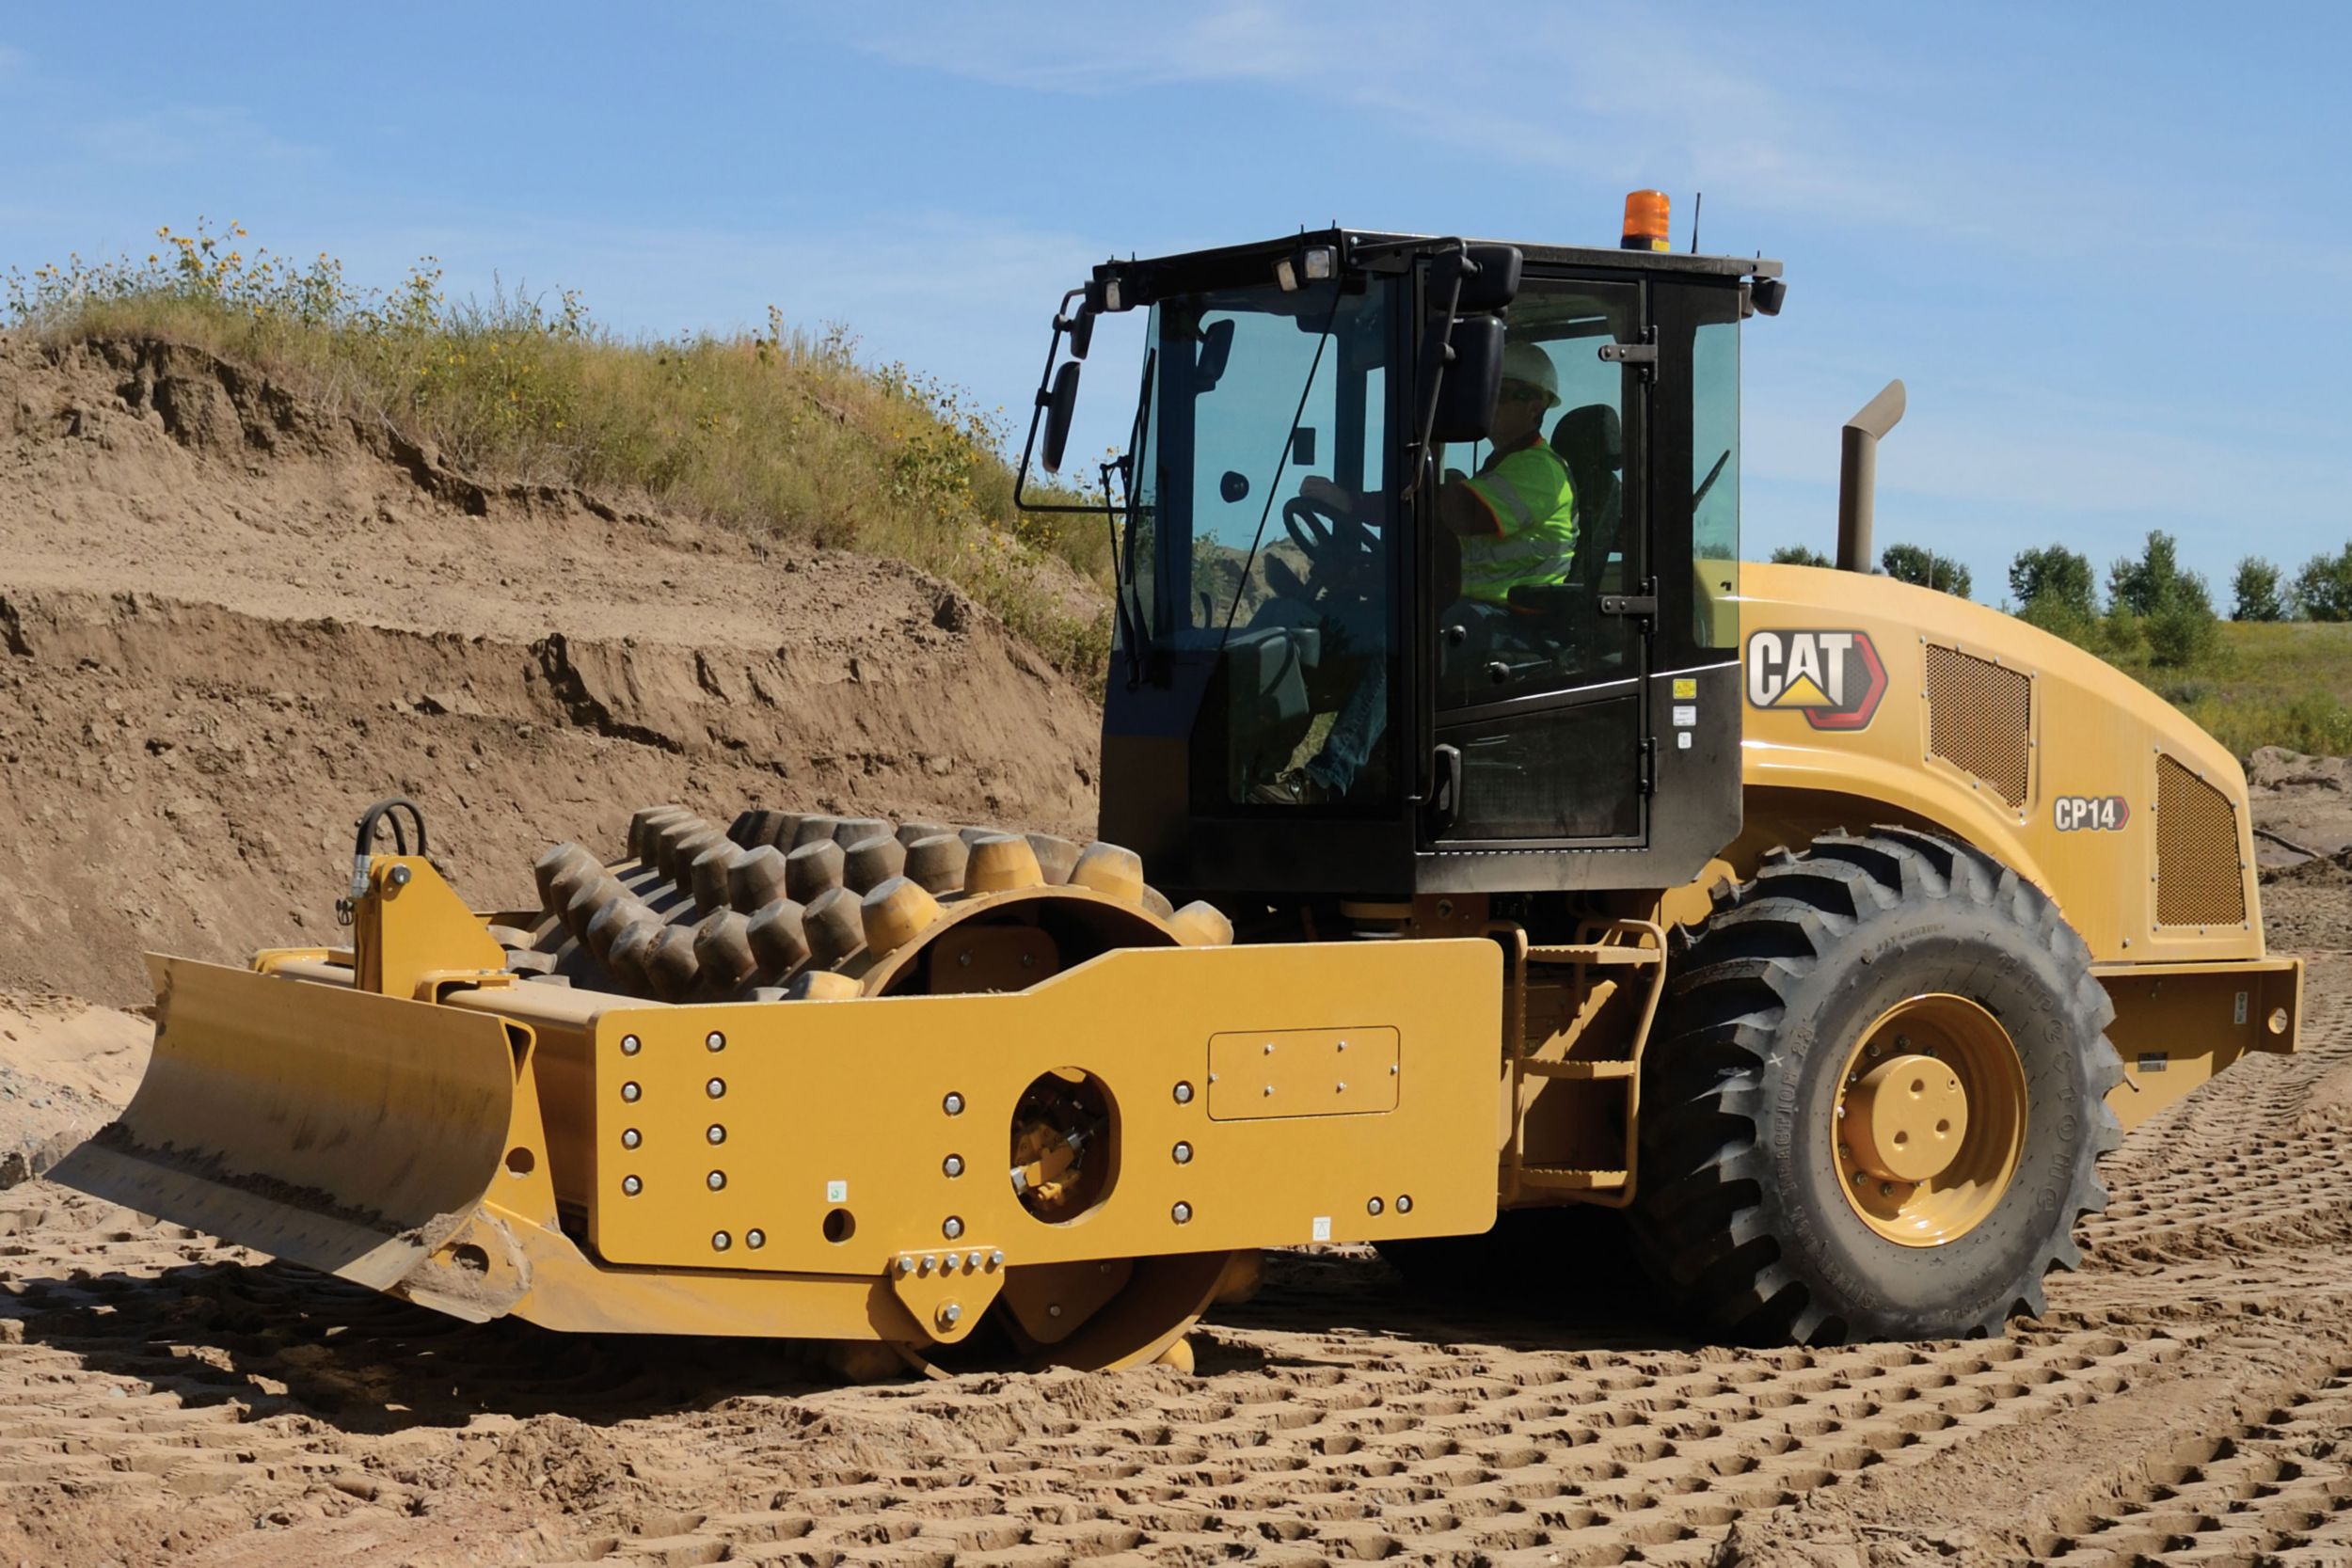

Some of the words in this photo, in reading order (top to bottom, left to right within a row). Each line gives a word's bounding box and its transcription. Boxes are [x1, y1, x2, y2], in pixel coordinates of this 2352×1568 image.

[1749, 632, 1852, 706] CAT
[2056, 798, 2115, 830] CP14
[1775, 1067, 1800, 1196] TRACTION
